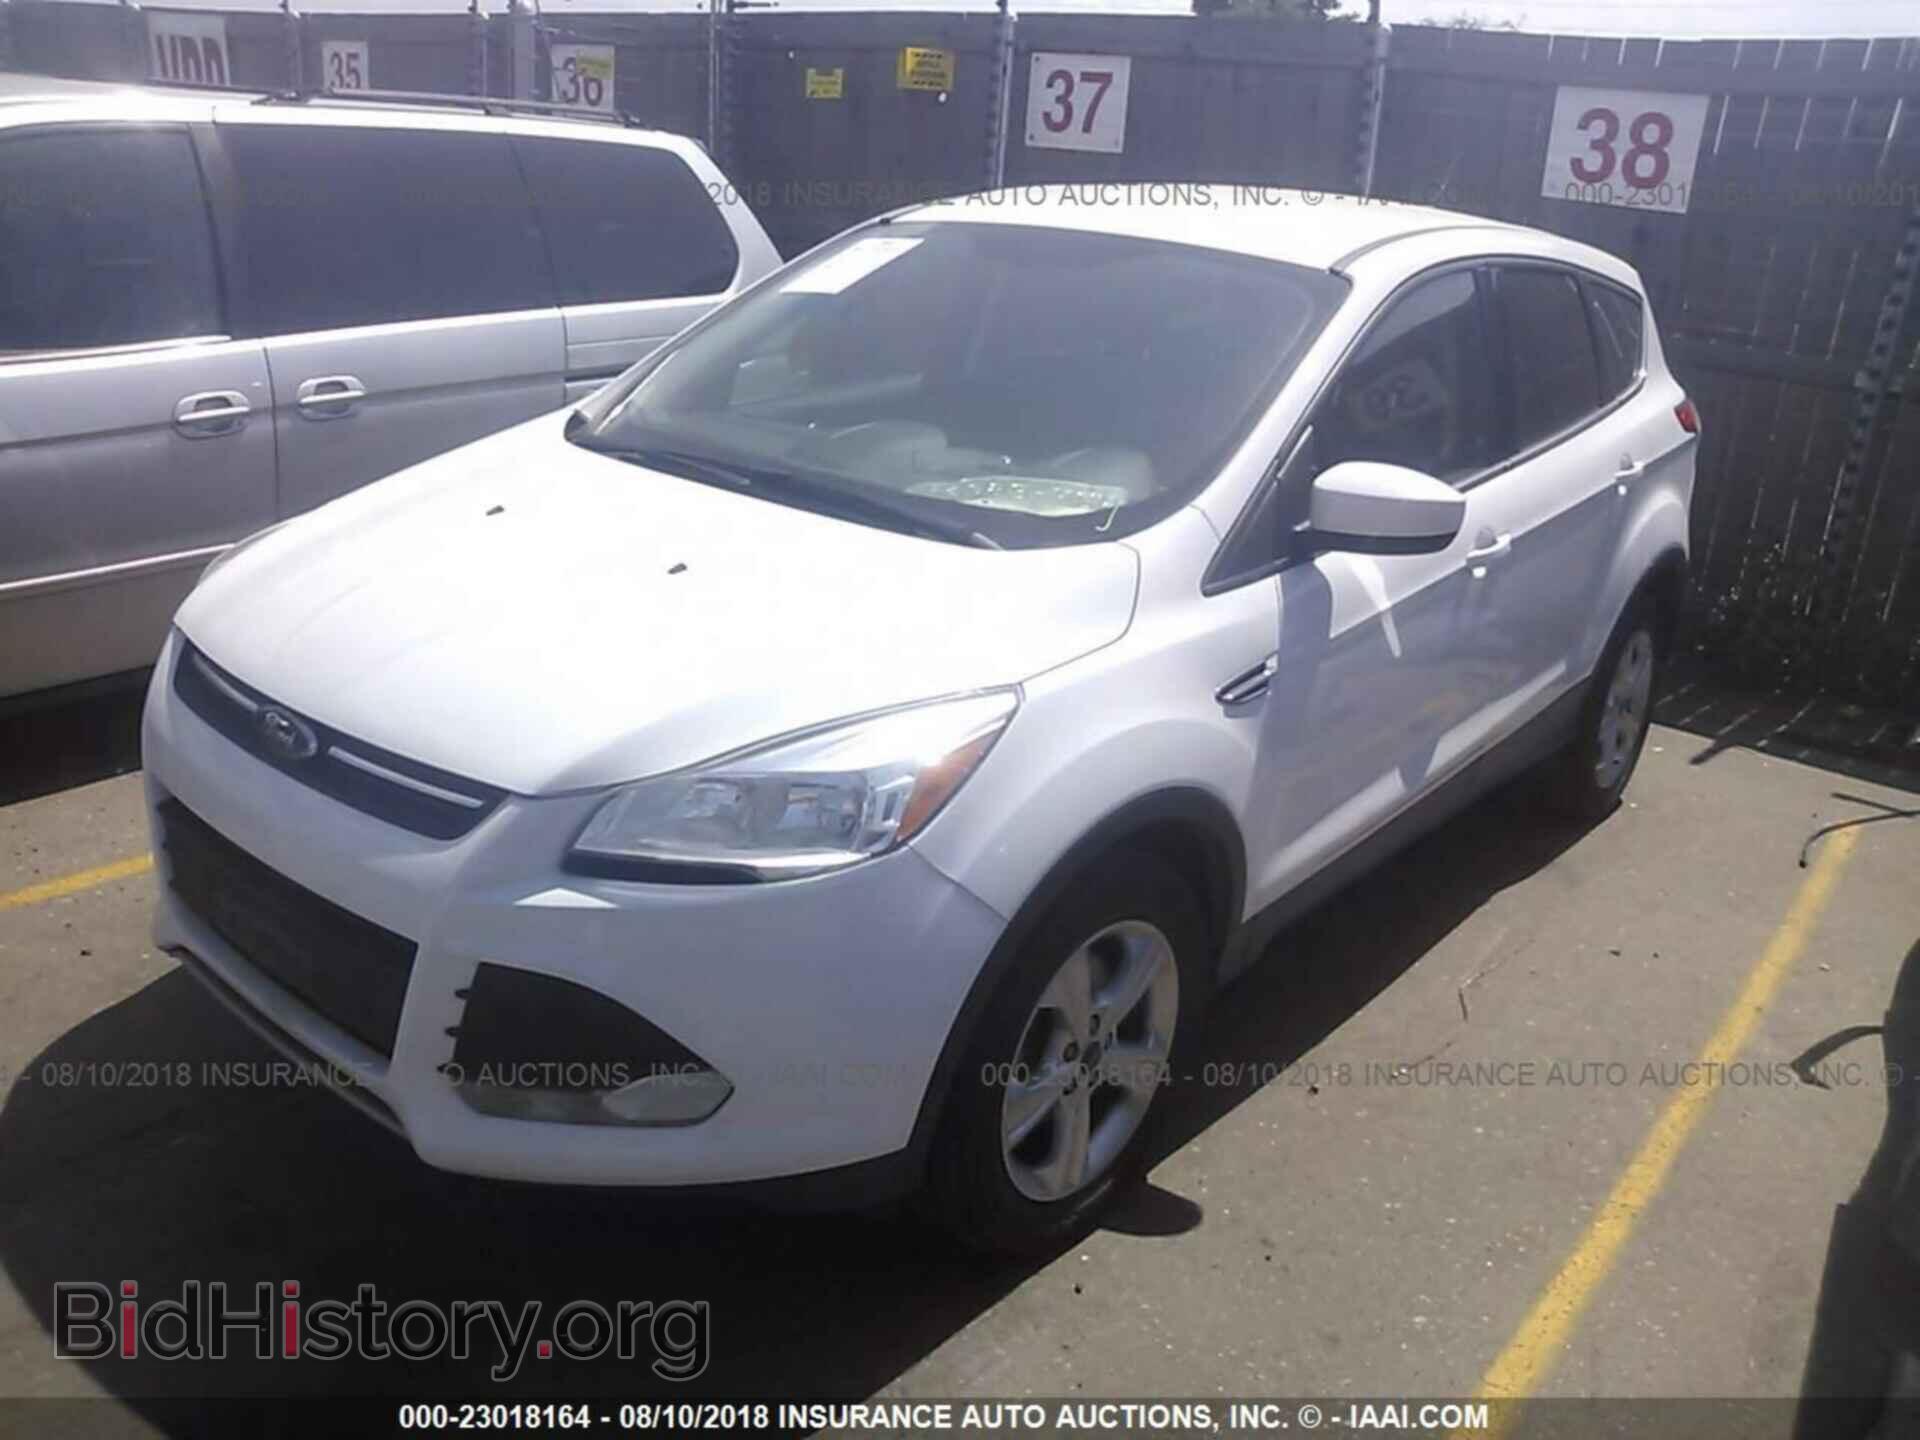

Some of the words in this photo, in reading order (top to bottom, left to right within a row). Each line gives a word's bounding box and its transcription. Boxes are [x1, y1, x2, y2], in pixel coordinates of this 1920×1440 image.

[329, 51, 362, 91] 35
[1041, 69, 1114, 134] 37
[1568, 107, 1675, 189] 38
